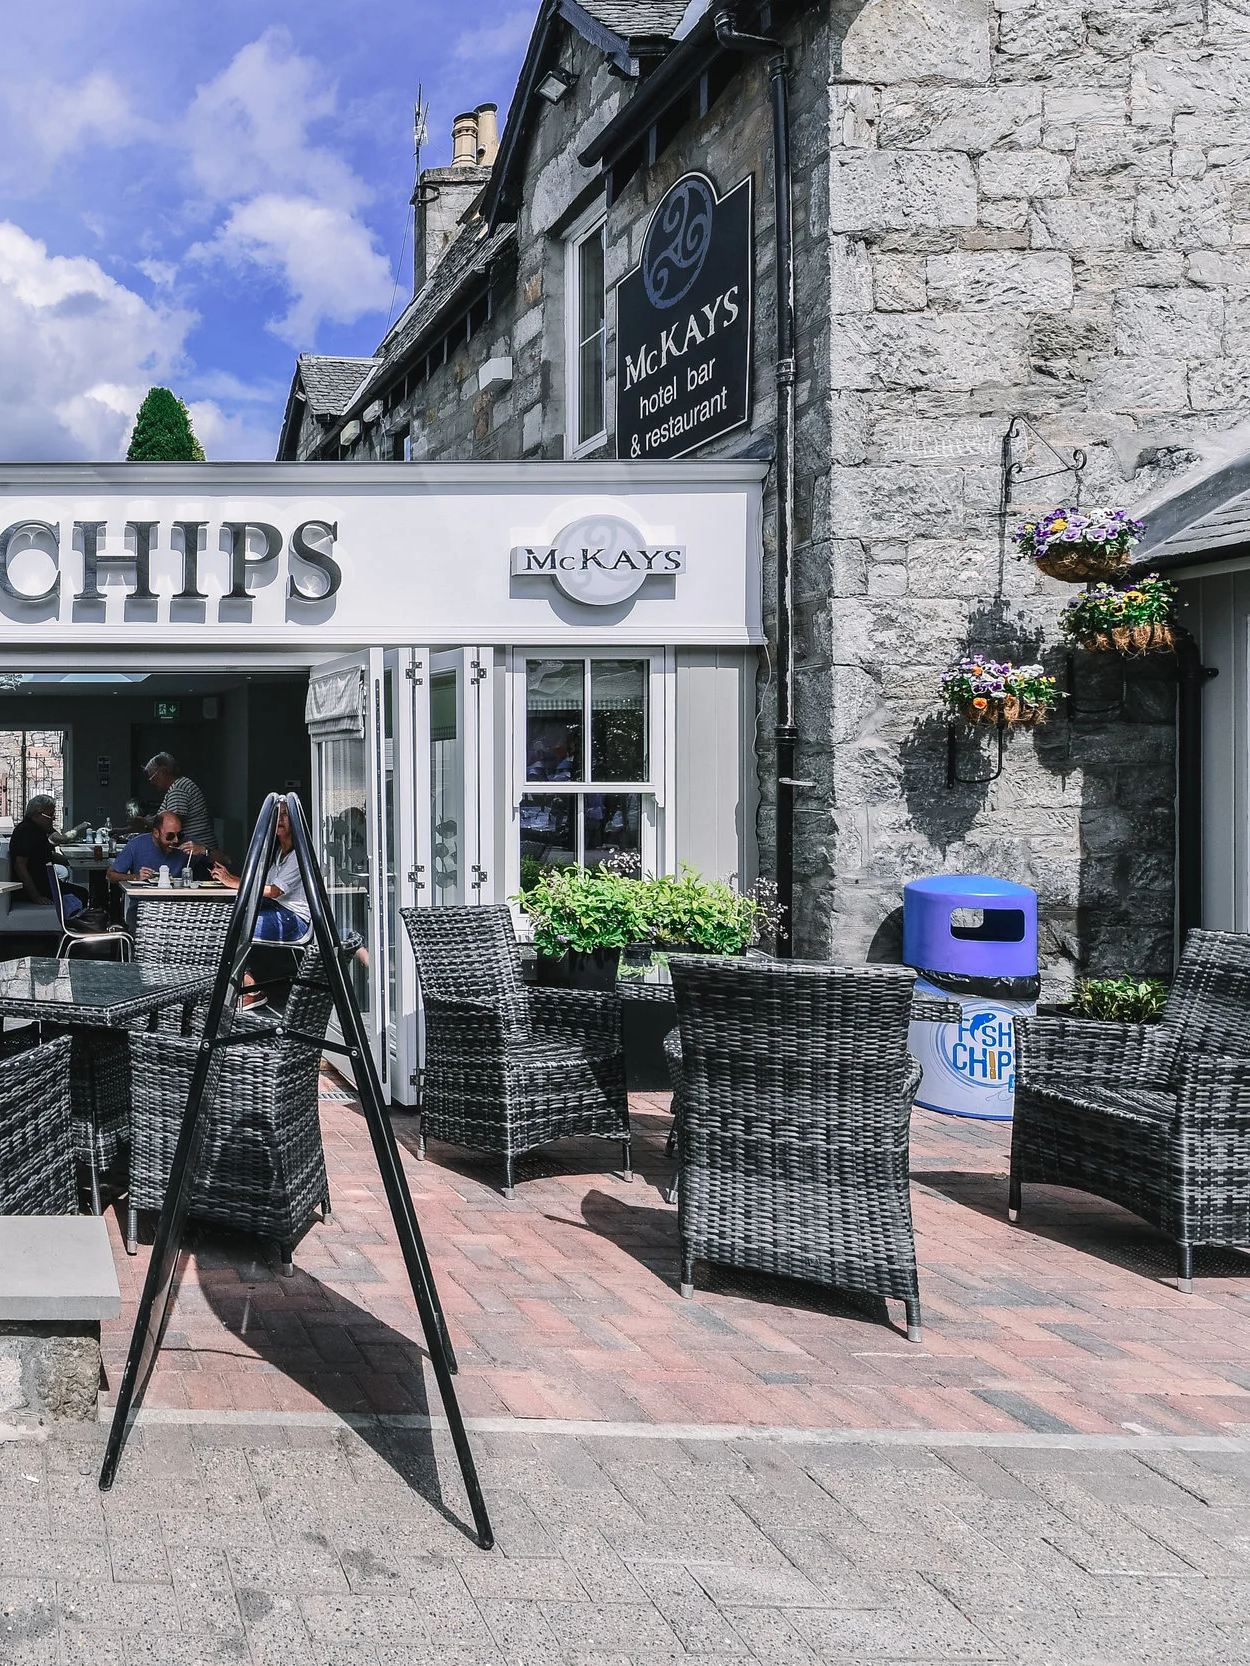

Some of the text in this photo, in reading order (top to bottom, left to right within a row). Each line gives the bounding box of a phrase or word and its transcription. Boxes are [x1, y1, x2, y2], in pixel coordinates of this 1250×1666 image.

[623, 285, 740, 391] McKAYS
[639, 358, 716, 420] hotel bar
[630, 387, 728, 459] & restaurant
[522, 548, 682, 571] McKAYS
[952, 1042, 1015, 1080] CHIP
